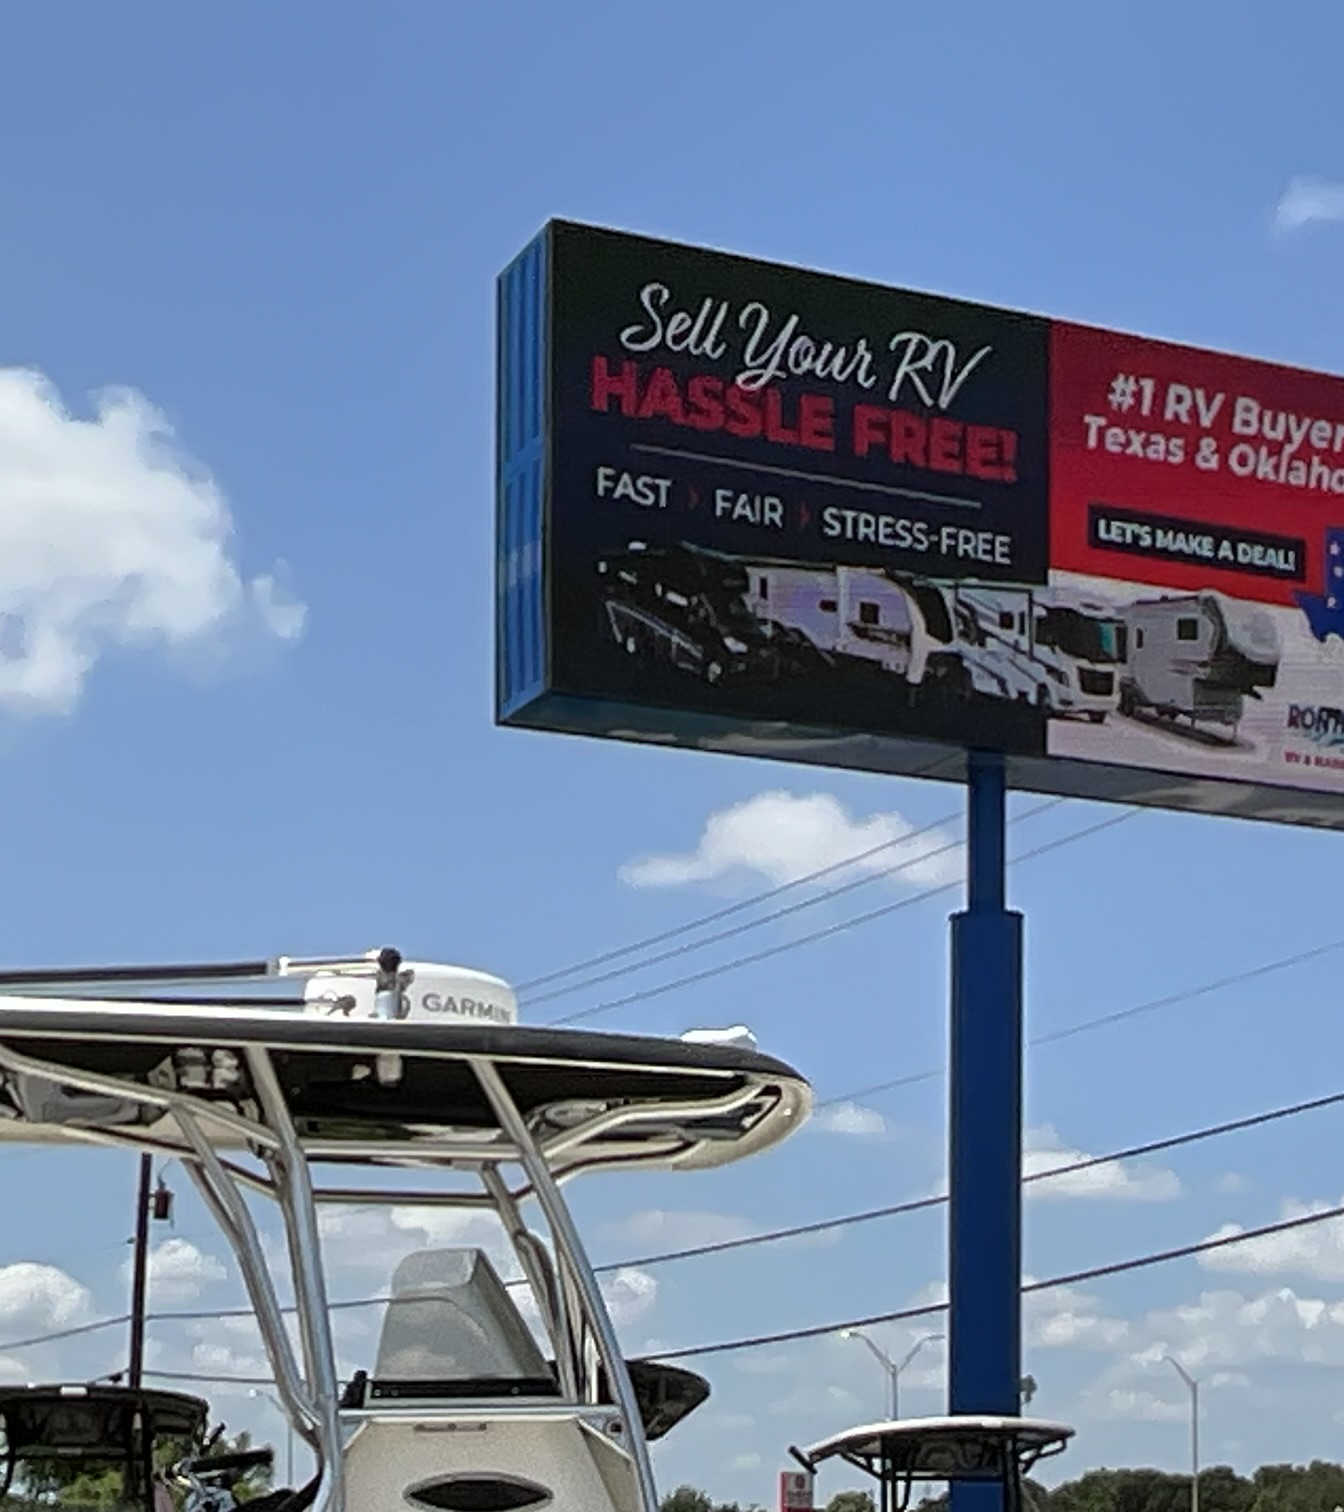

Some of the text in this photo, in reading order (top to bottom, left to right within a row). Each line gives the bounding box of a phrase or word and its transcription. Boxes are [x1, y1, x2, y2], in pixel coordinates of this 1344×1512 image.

[620, 282, 993, 410] Sell Your RV
[590, 354, 1019, 483] HASSLE FREE!
[1107, 372, 1156, 417] #1
[1164, 383, 1226, 428] RV
[1083, 414, 1185, 465] Texas
[1195, 437, 1220, 471] &
[597, 466, 672, 508] FAST
[714, 488, 784, 528] FAIR
[823, 506, 1013, 565] STRESS-FREE
[1097, 518, 1297, 572] LET'S MAKE A DEAL!
[422, 992, 511, 1024] GARMIN
